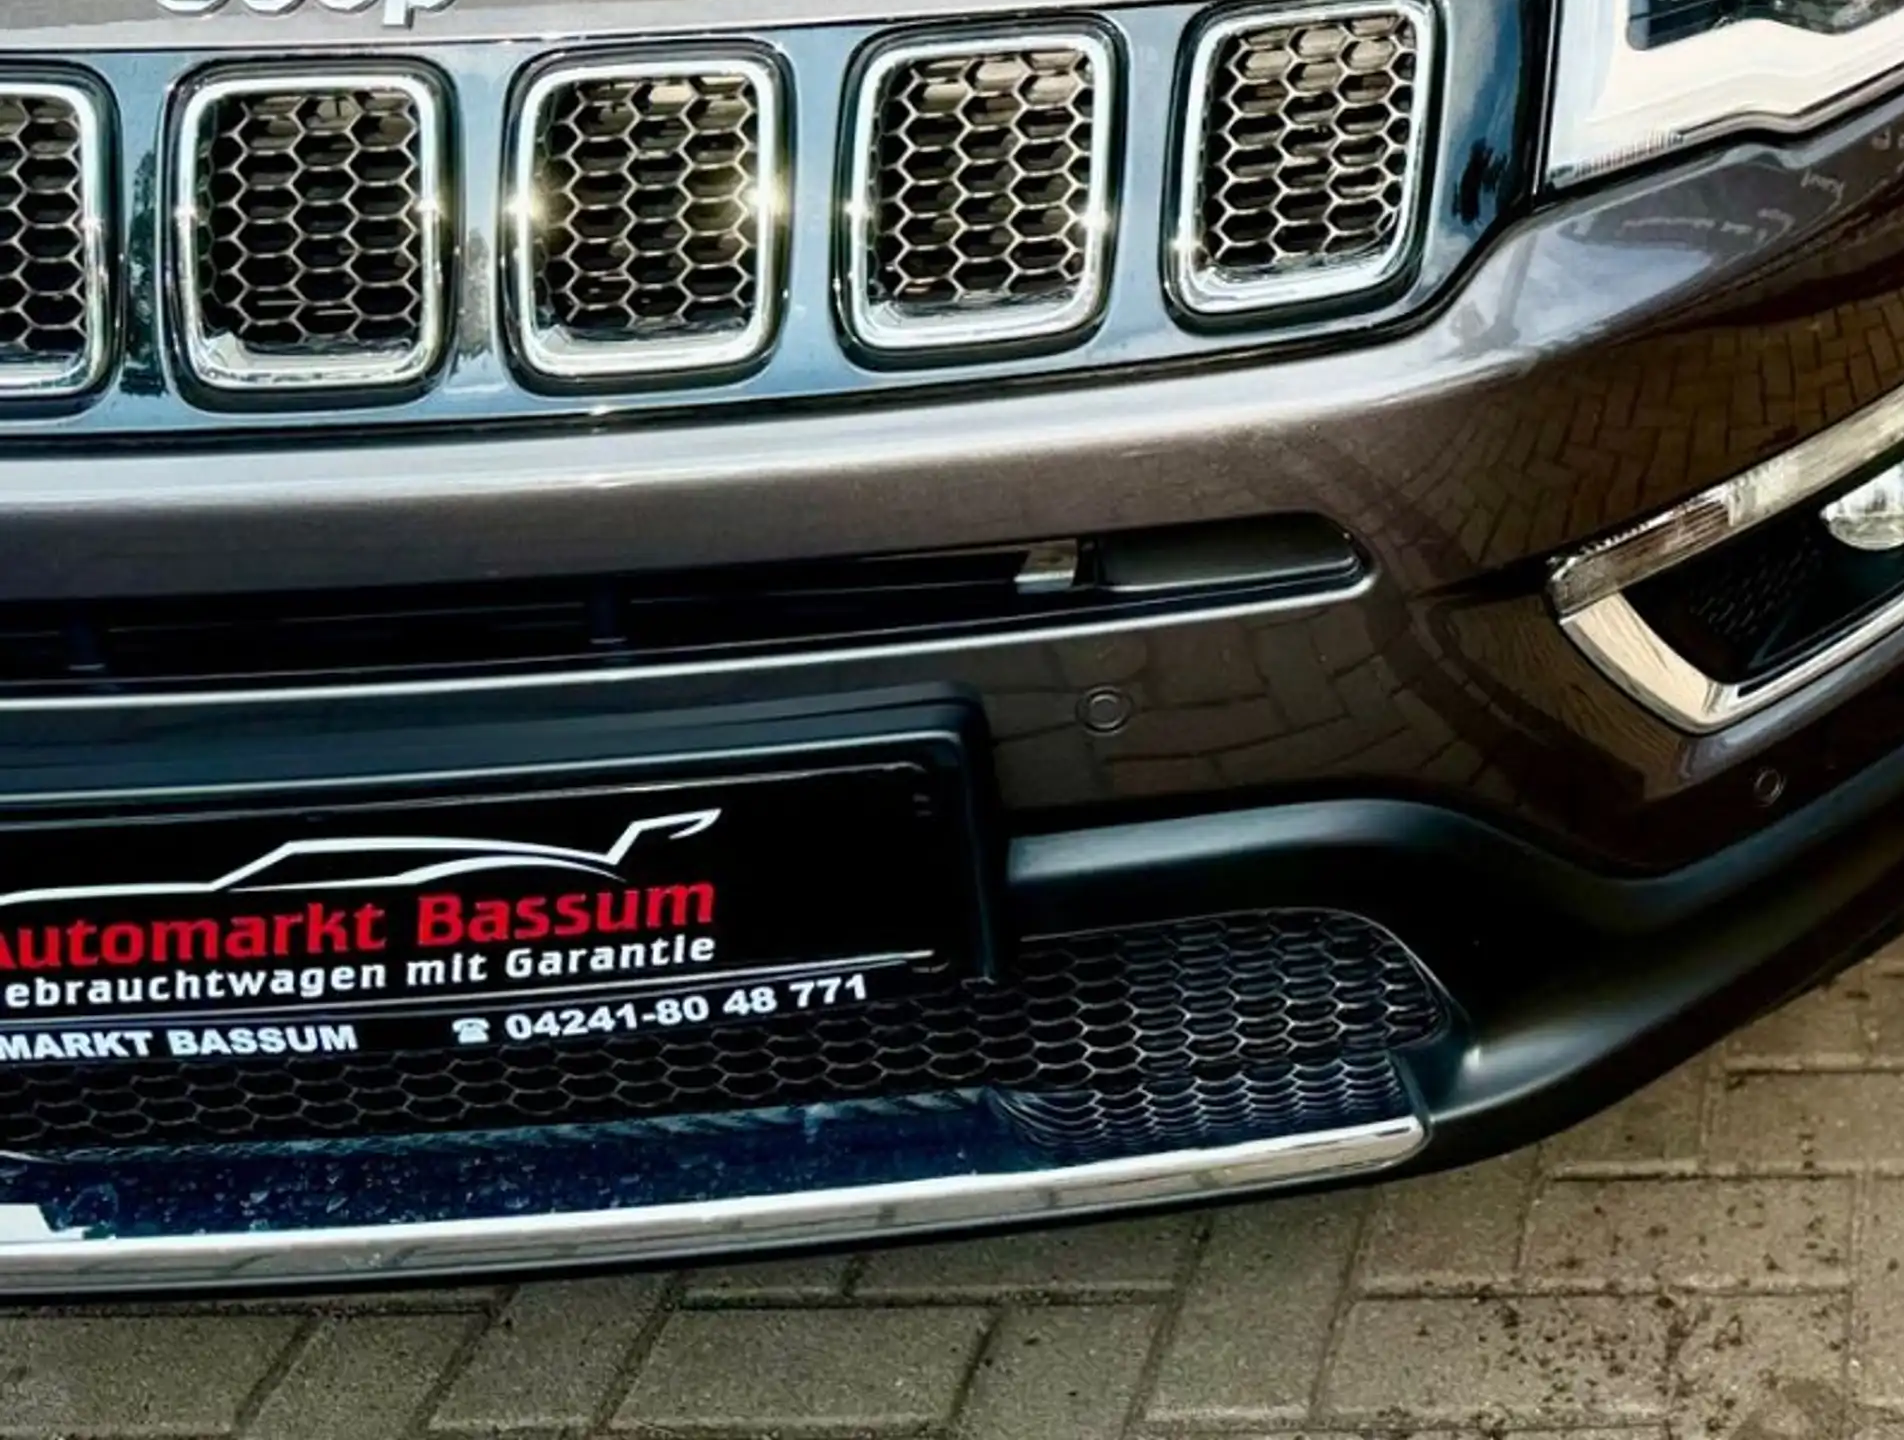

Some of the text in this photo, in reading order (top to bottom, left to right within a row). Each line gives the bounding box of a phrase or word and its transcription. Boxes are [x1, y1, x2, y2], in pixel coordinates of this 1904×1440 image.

[416, 880, 717, 948] Bassum
[405, 952, 488, 987] mit
[504, 934, 717, 979] Garantie
[505, 972, 869, 1042] 04241-80 48 771
[166, 1024, 359, 1057] BASSUM
